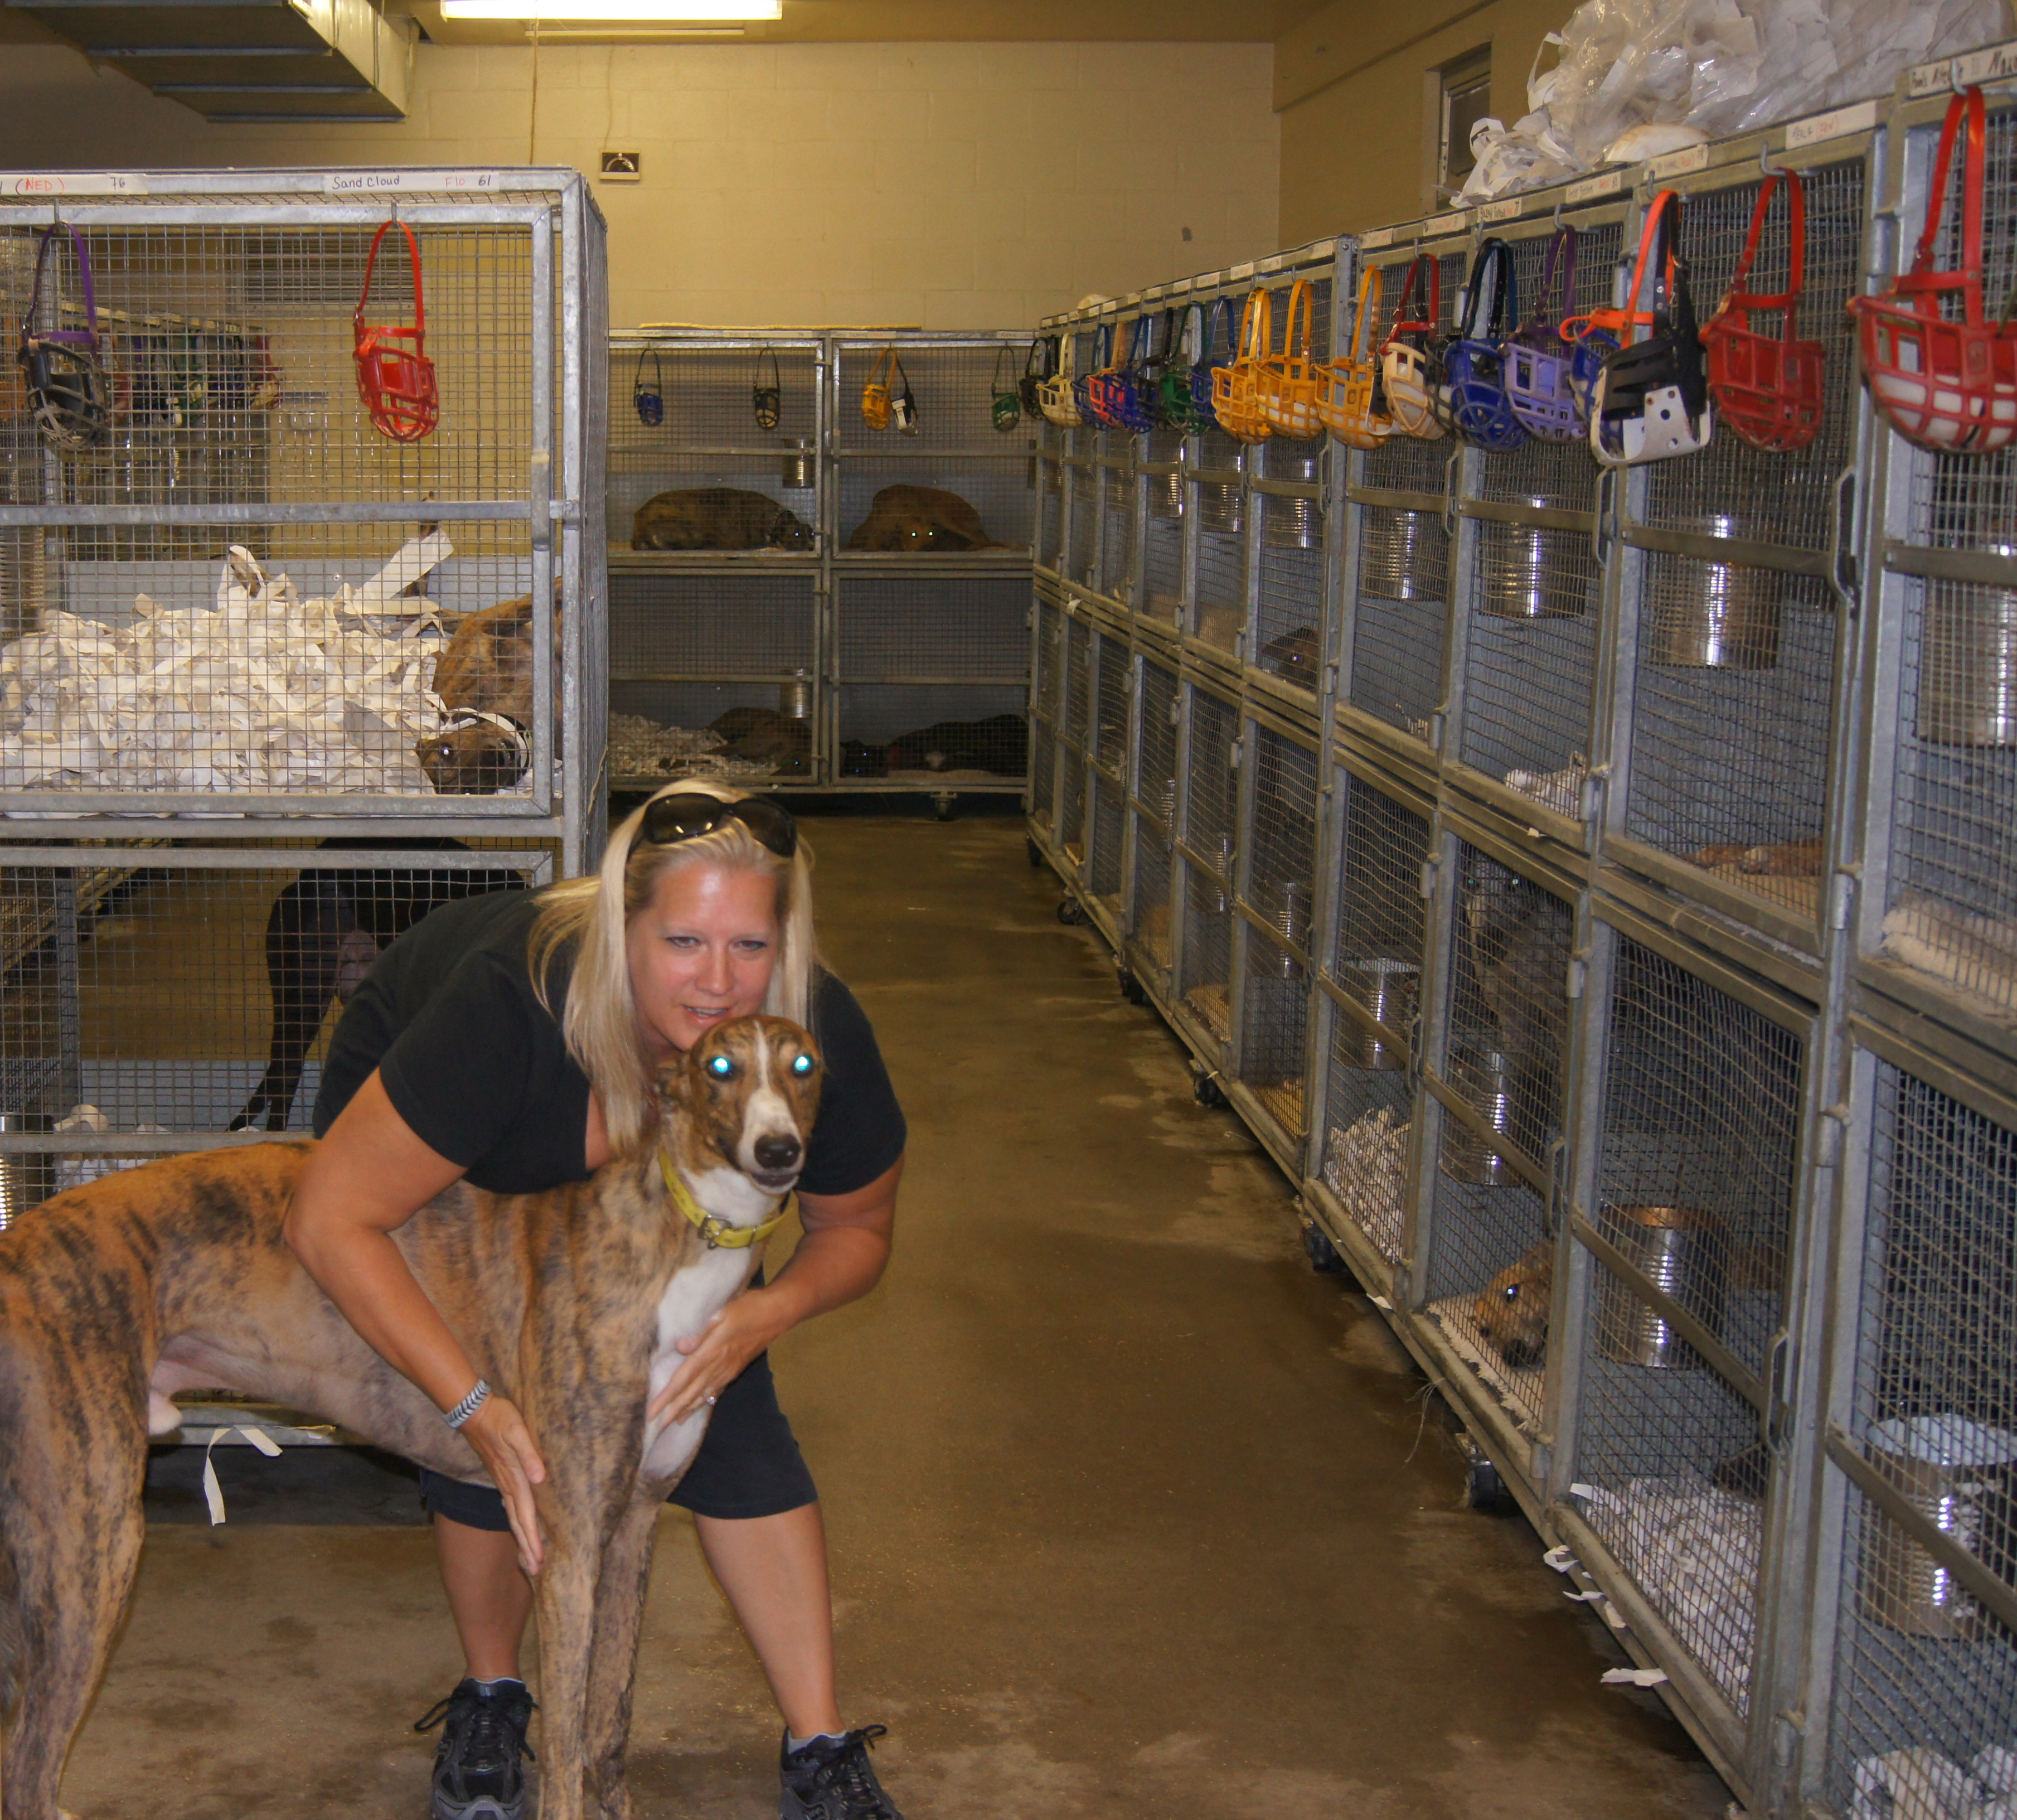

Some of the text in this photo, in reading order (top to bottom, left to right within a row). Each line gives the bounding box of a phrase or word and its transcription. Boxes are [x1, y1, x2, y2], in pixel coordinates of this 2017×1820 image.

[109, 176, 125, 191] 76
[332, 176, 362, 190] Sand
[367, 175, 400, 187] Cloud
[478, 175, 491, 186] 61
